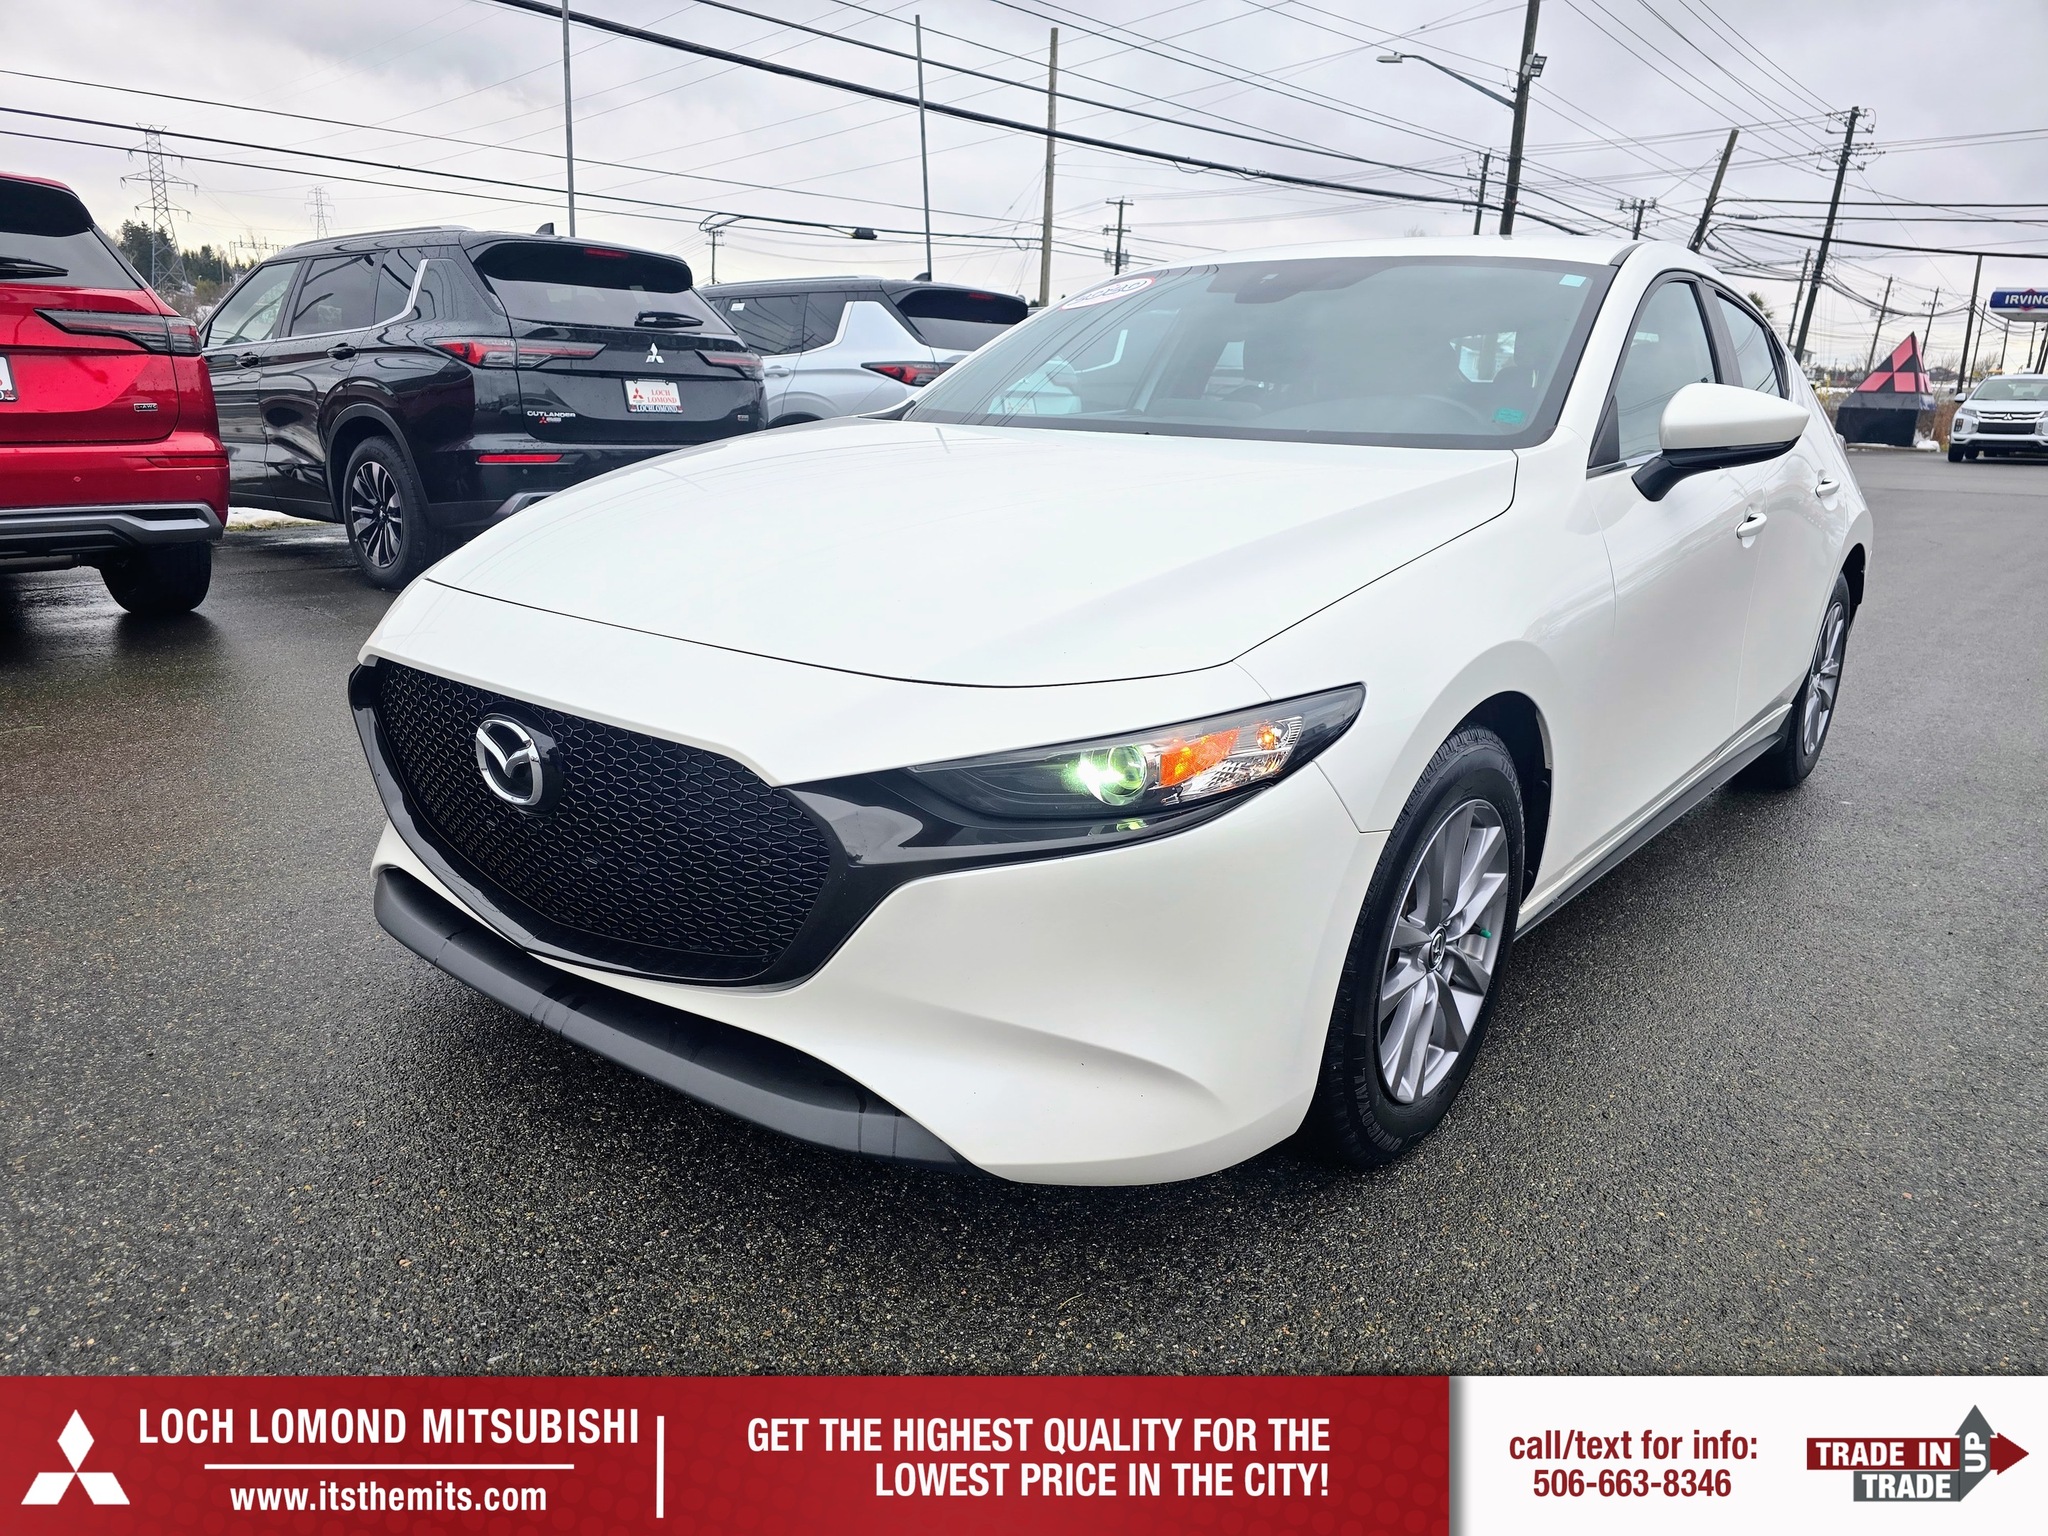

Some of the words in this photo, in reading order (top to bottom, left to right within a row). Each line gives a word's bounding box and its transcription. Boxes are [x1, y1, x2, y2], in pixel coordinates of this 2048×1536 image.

[2004, 294, 2048, 305] IRVING
[526, 410, 576, 418] OUTLANDER
[1353, 1067, 1403, 1152] UNIROYAL
